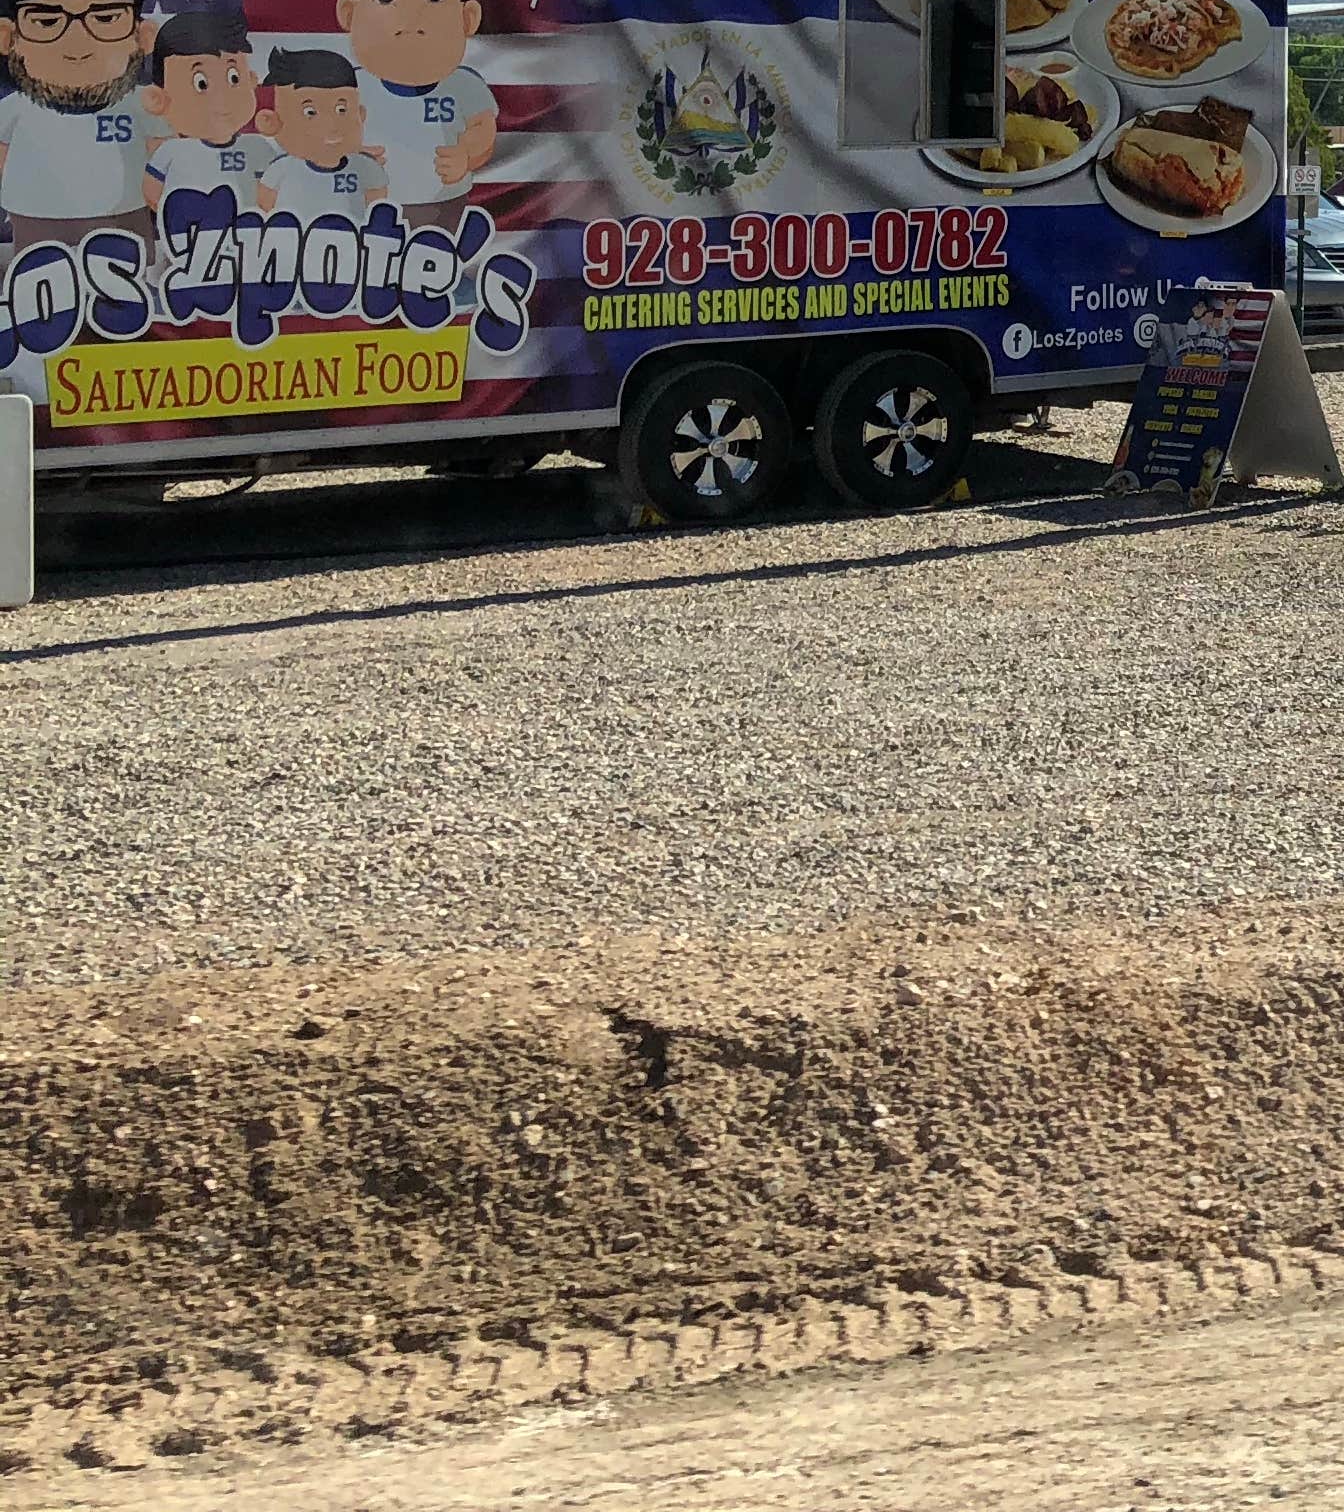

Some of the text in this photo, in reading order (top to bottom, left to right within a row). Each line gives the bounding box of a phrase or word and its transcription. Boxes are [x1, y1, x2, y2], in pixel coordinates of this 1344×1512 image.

[424, 97, 455, 122] ES
[95, 115, 133, 142] ES
[220, 151, 246, 171] ES
[333, 173, 358, 193] ES
[584, 205, 1008, 288] 928-300-0782
[162, 184, 535, 352] Zpote's
[584, 274, 1009, 331] CATERING SERVICES AND SPECIAL EVENTS
[1070, 278, 1186, 311] Follow U
[1033, 326, 1124, 350] LosZpotes
[55, 342, 459, 415] SALVADORIAN FOOD
[1164, 366, 1229, 387] WELCOME
